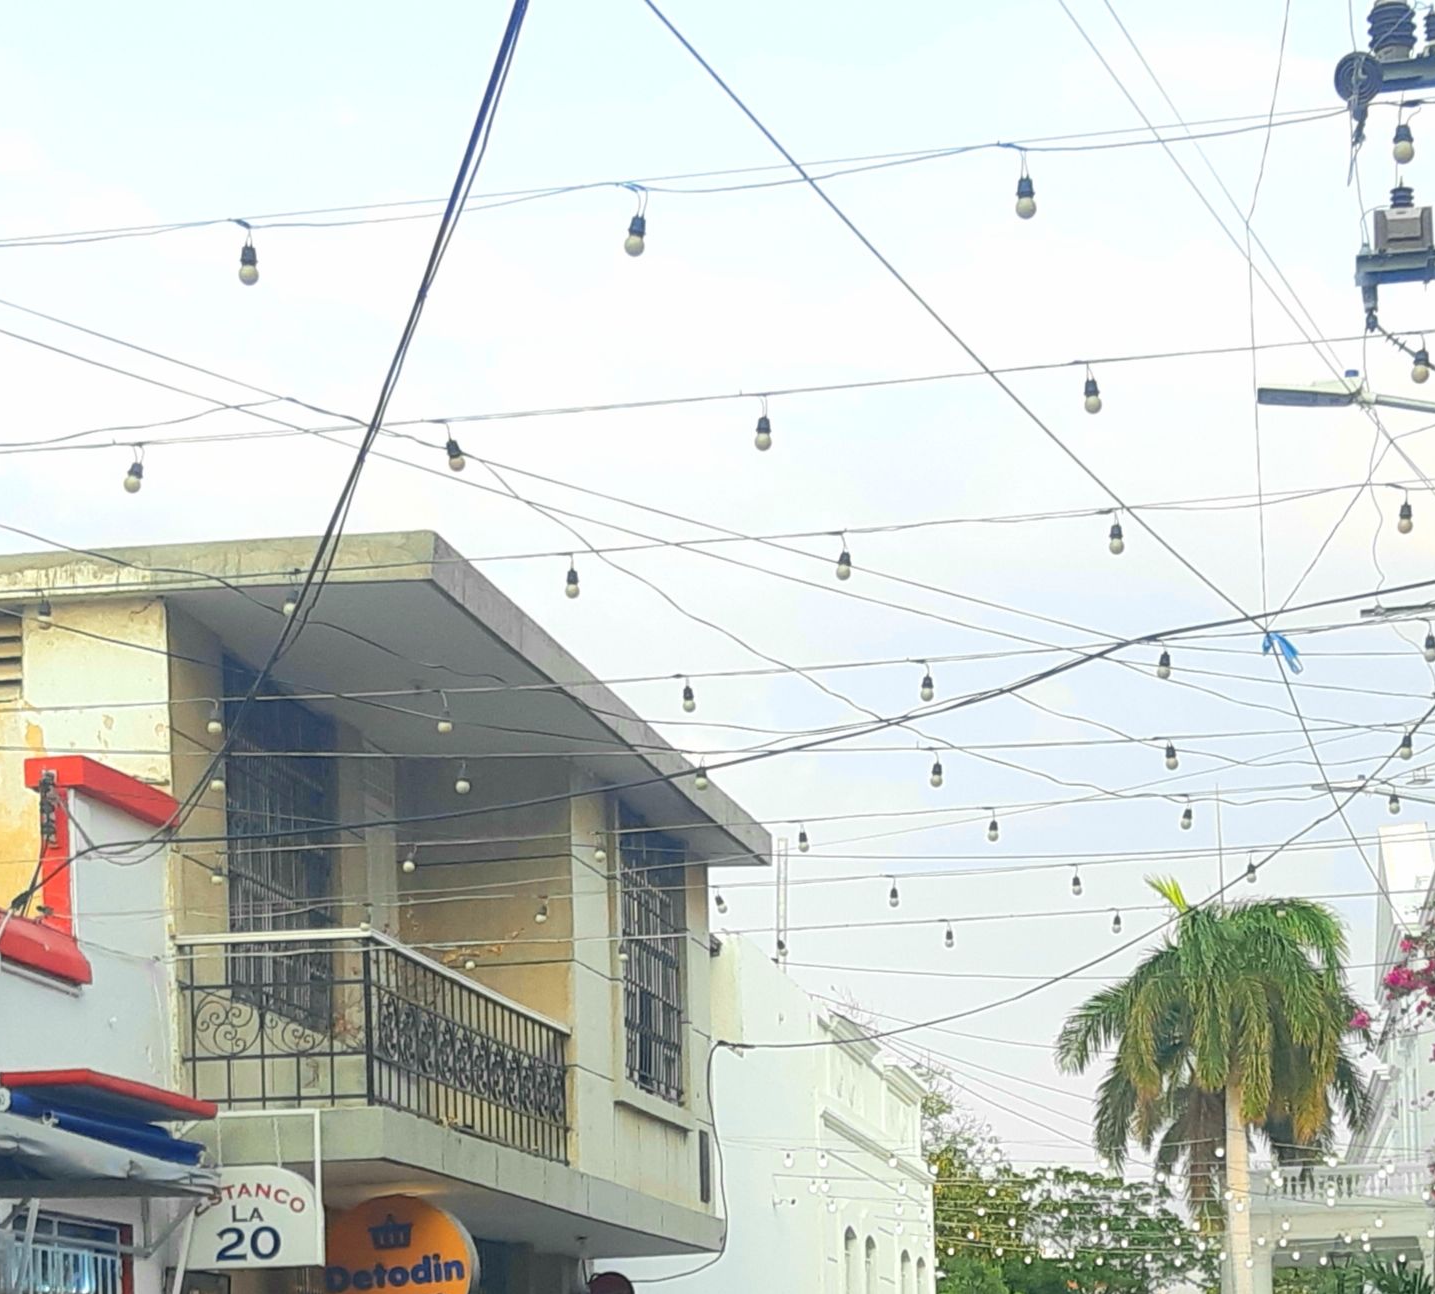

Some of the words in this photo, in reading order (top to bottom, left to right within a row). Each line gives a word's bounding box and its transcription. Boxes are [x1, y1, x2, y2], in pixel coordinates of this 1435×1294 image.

[231, 1205, 264, 1223] LA
[216, 1226, 281, 1262] 20
[326, 1253, 465, 1294] Detodin
